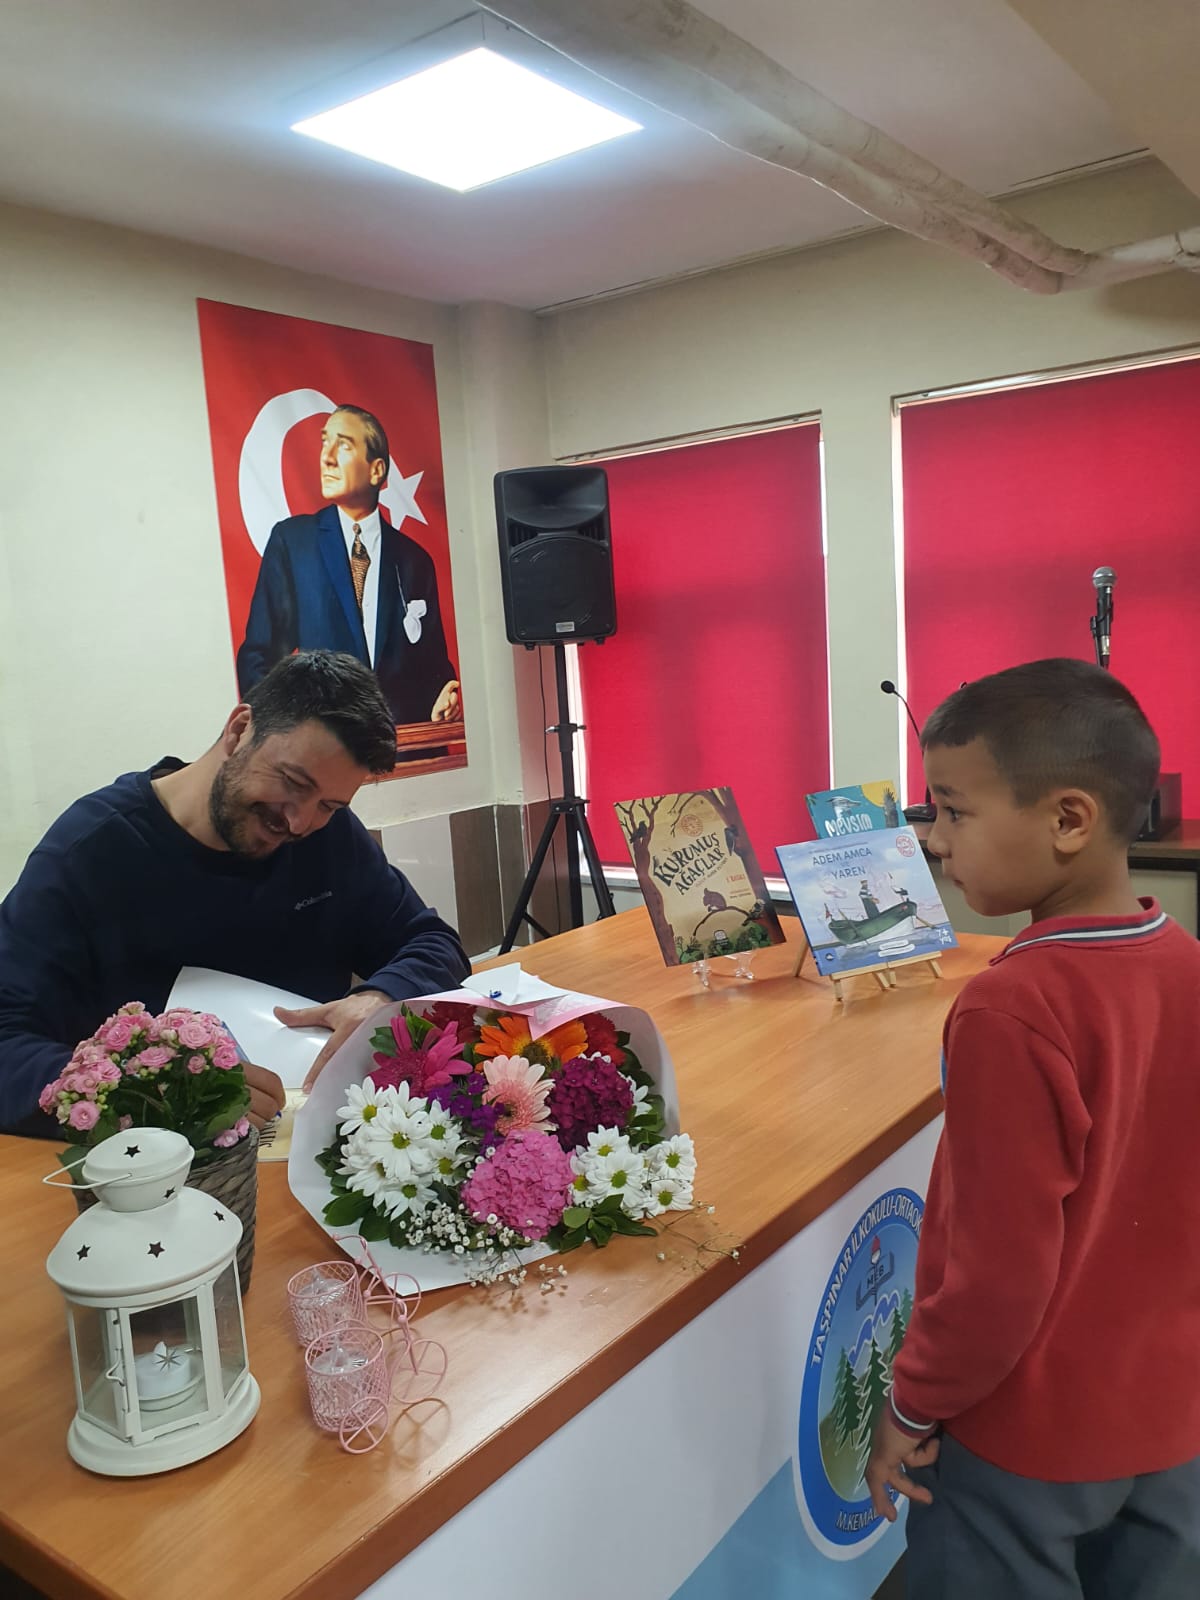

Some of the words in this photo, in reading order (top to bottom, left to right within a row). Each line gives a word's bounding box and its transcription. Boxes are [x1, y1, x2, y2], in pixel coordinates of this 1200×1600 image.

[652, 832, 720, 887] KURUMUŞ
[674, 845, 727, 896] AĞAÇLAR
[812, 852, 842, 866] ADEM
[844, 847, 873, 861] AMCA
[831, 865, 866, 880] YAREN
[866, 1264, 885, 1290] MEB
[811, 1247, 853, 1368] TAŞPINAR
